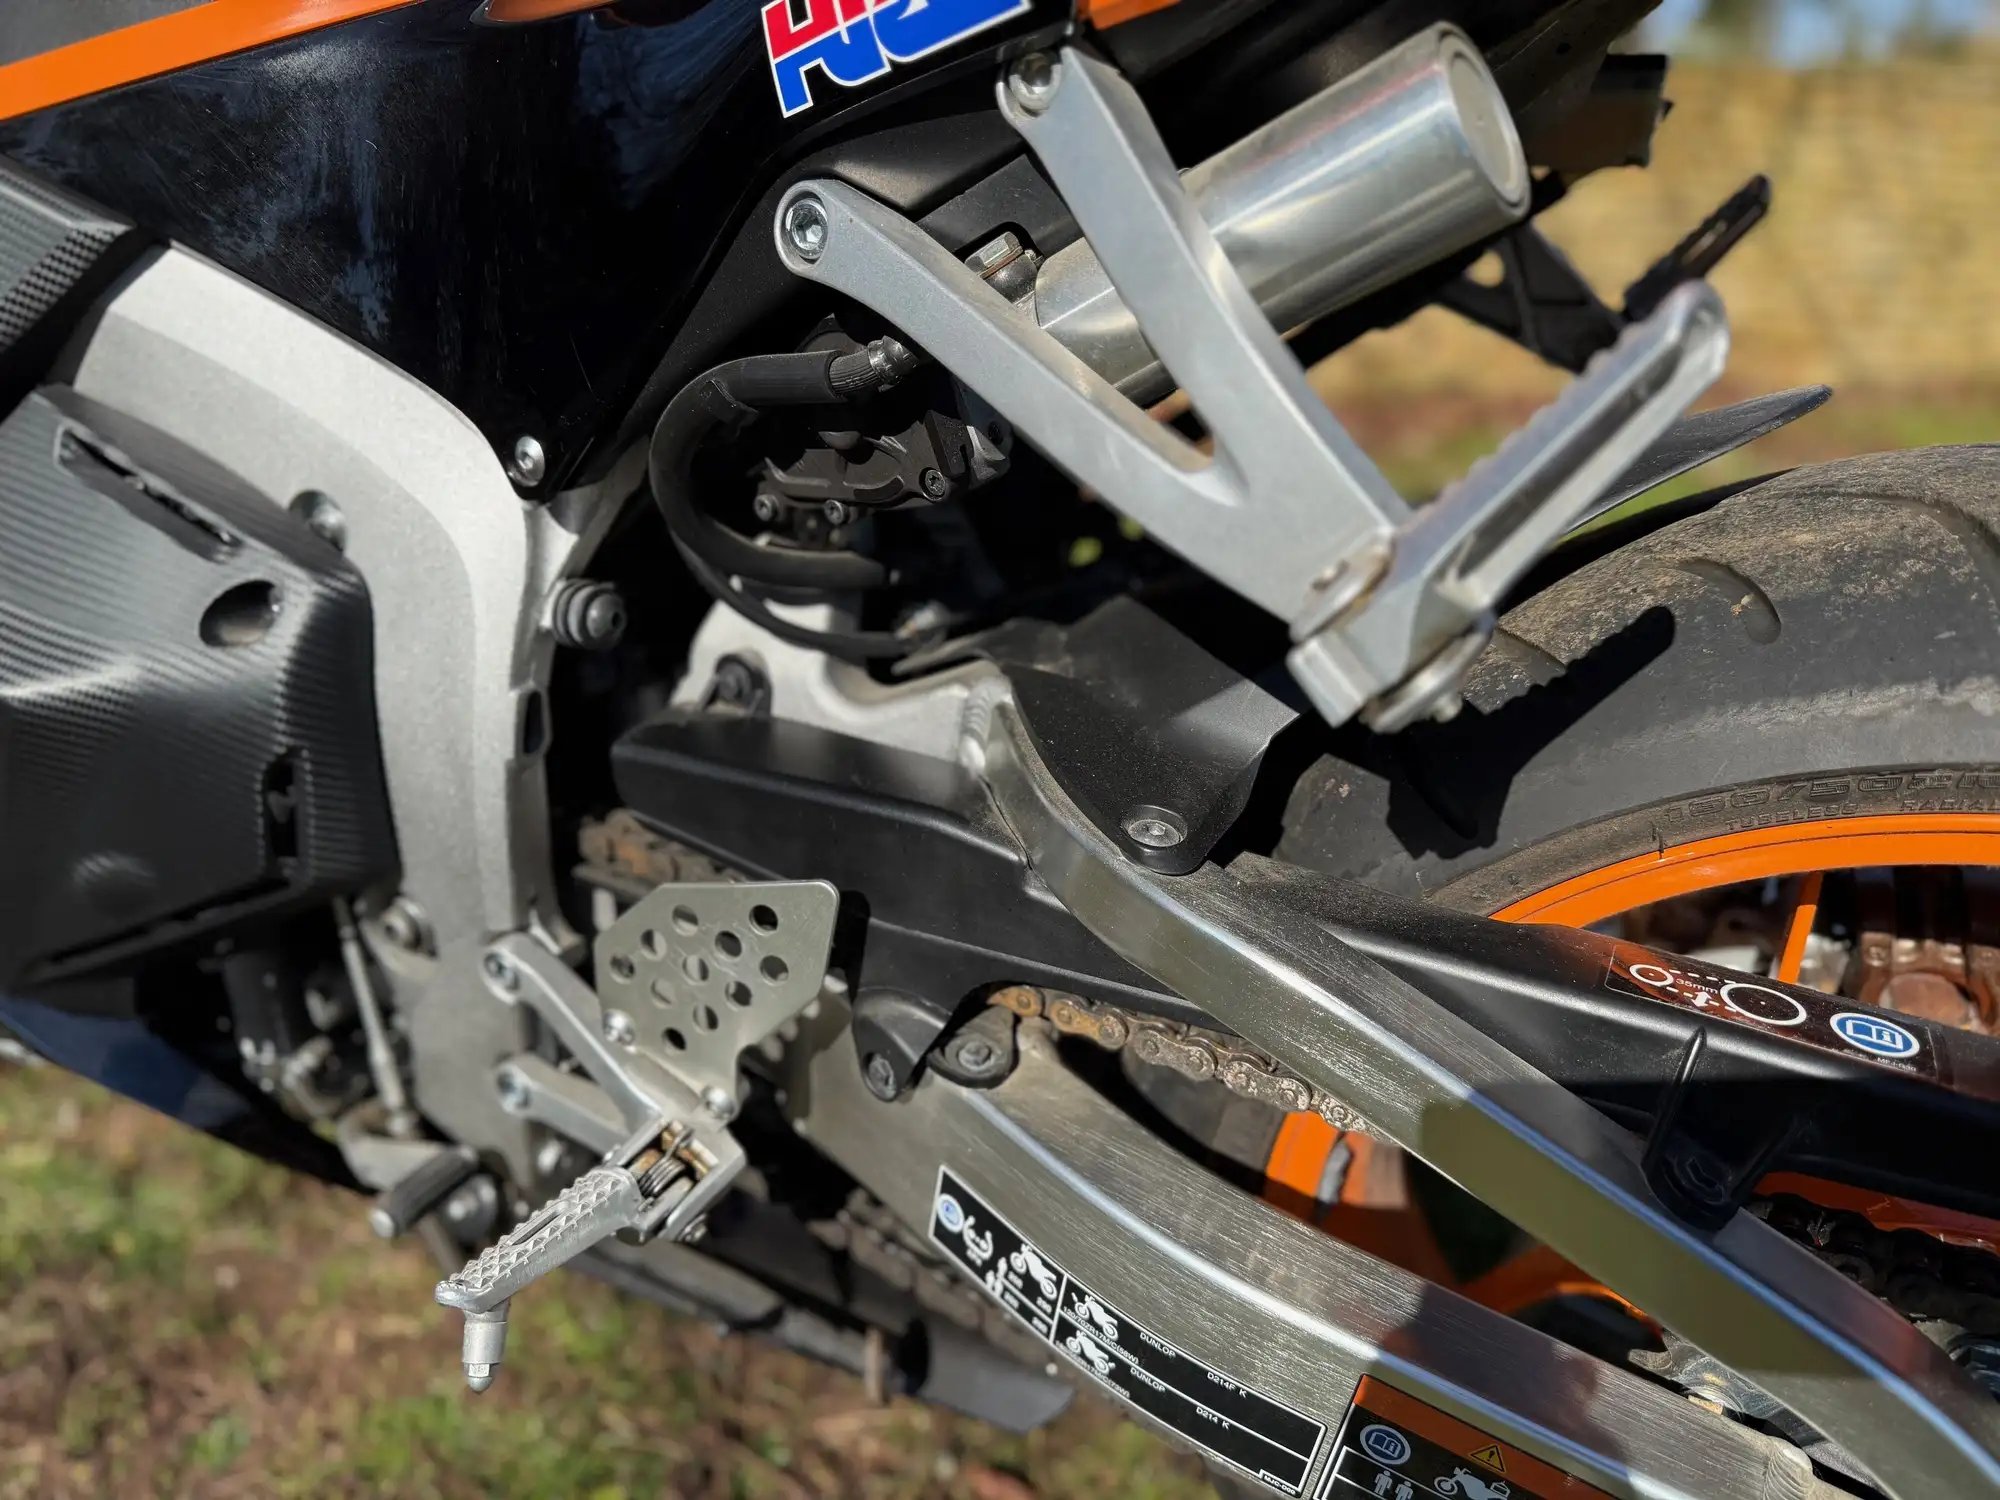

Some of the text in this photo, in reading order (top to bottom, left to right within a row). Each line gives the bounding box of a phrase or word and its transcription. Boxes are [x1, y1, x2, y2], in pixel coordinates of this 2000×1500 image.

[1675, 978, 1719, 995] 35mm
[1139, 1331, 1177, 1358] DUNLOP
[1130, 1366, 1166, 1394] DUNLOP
[1196, 1406, 1231, 1431] D214 K
